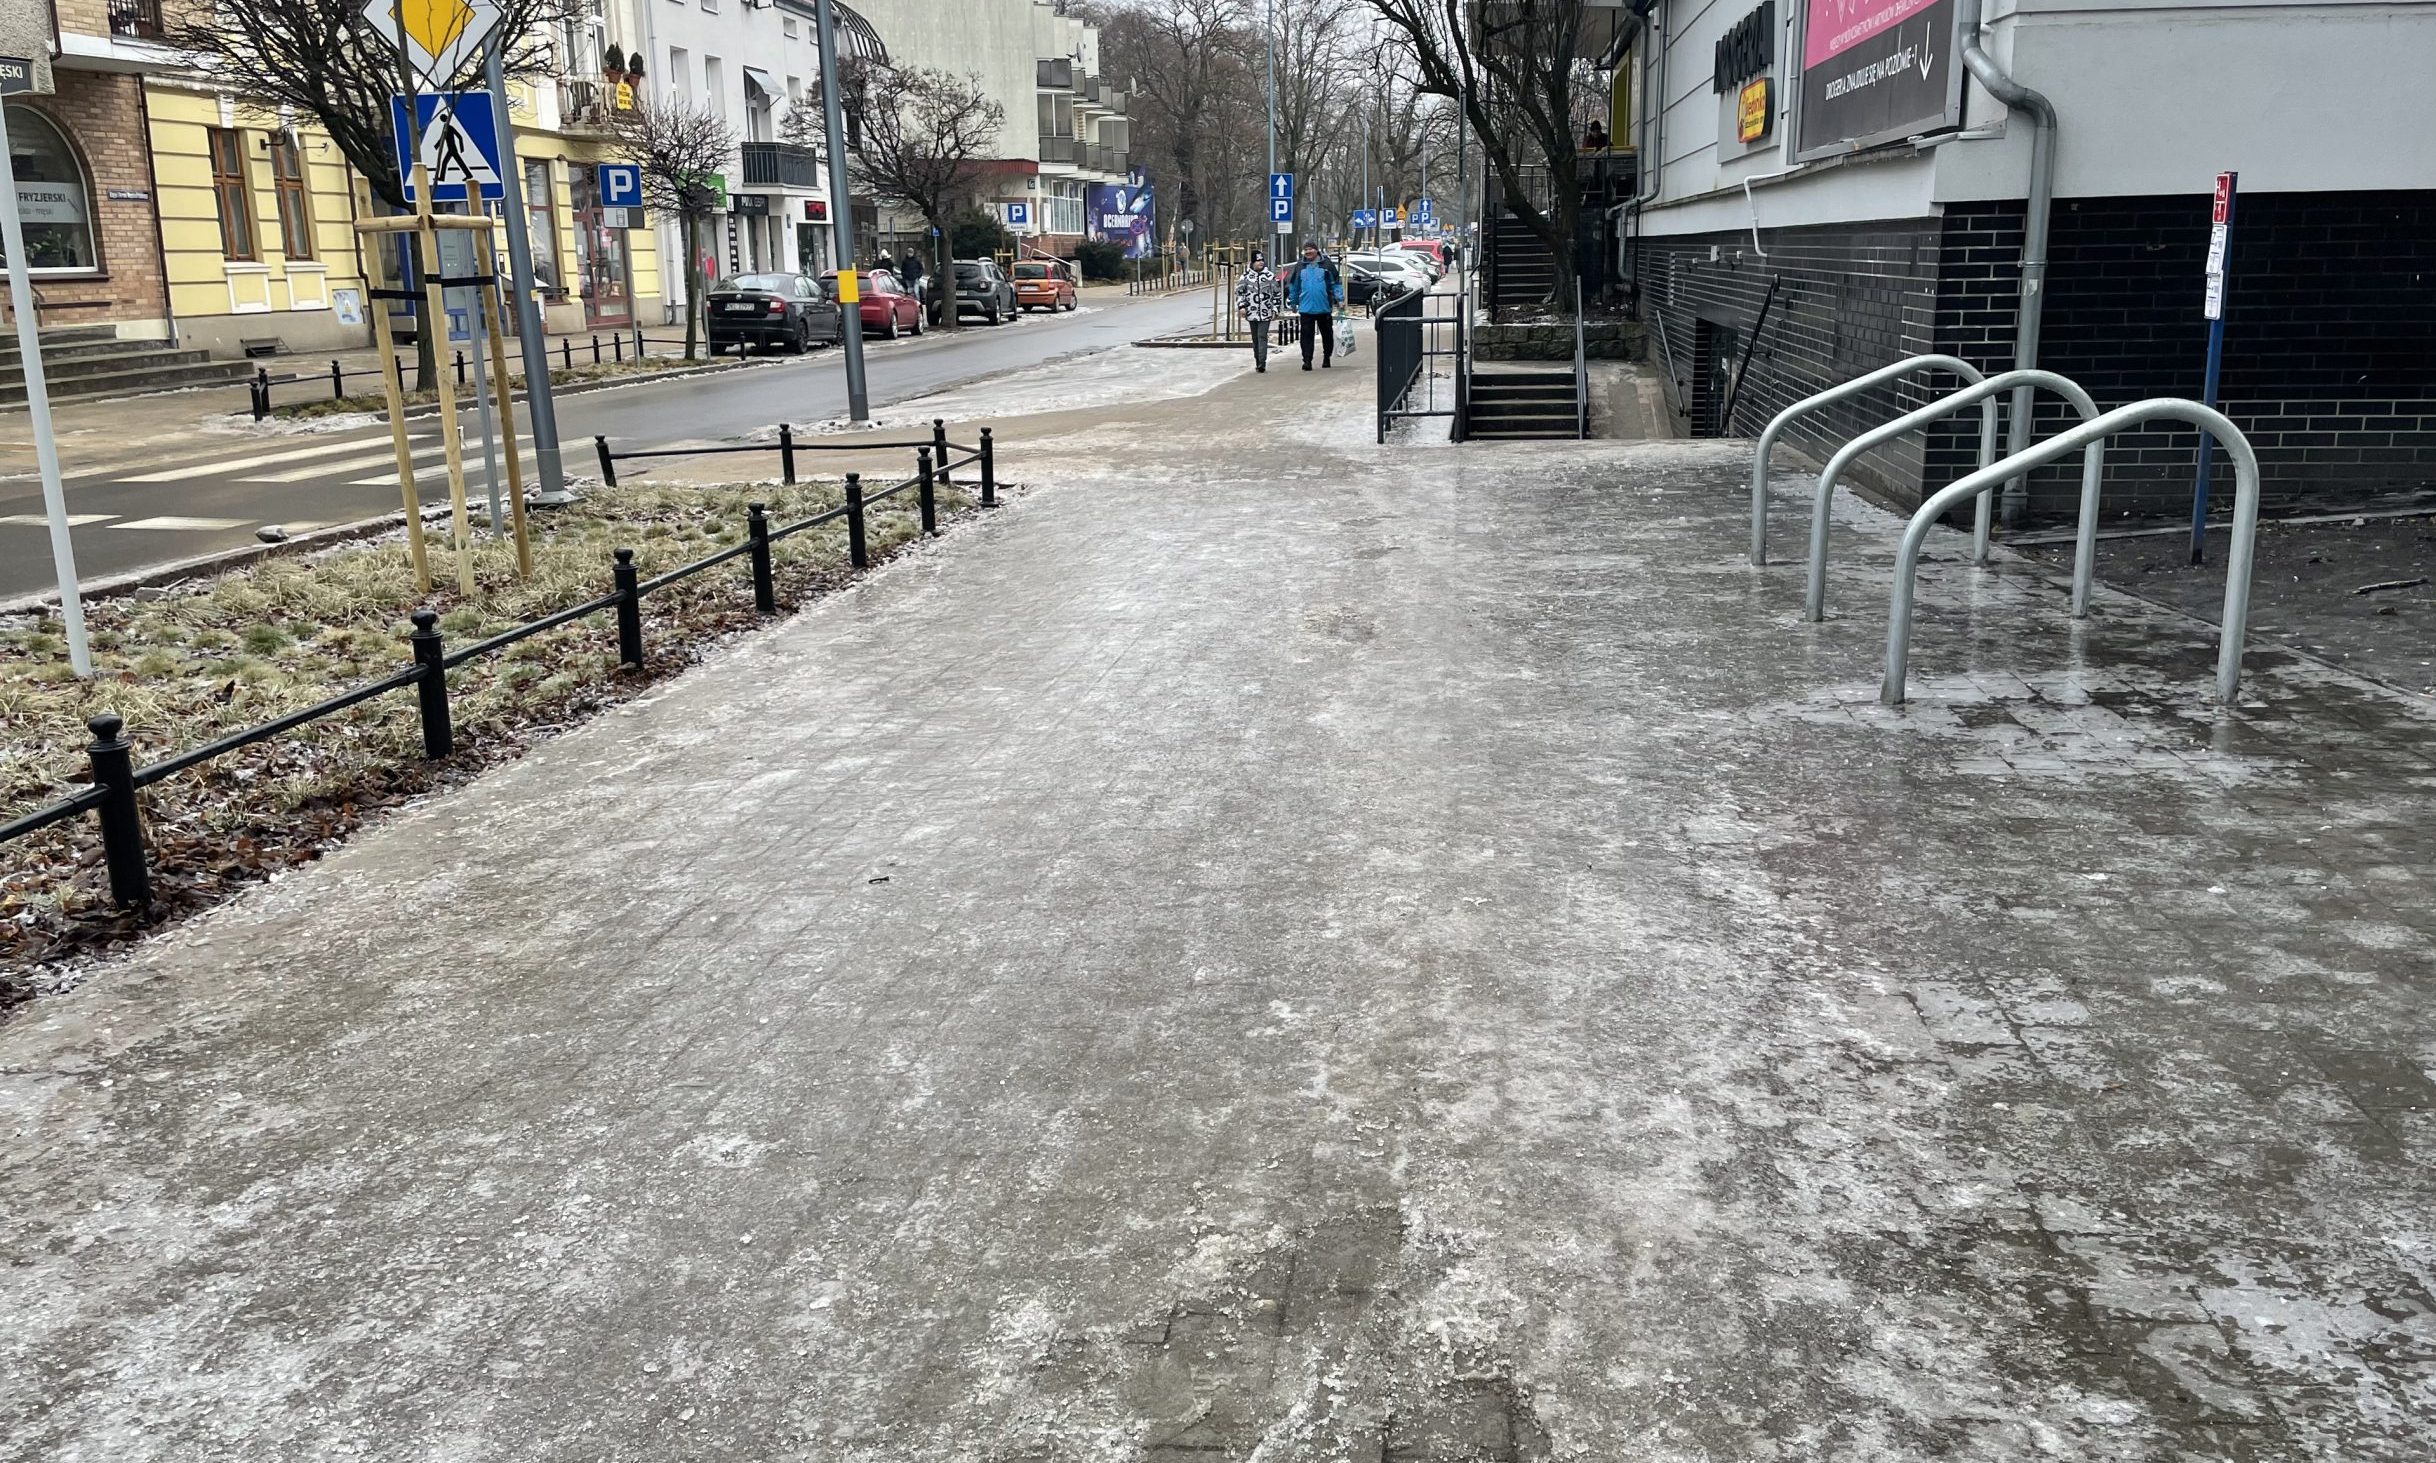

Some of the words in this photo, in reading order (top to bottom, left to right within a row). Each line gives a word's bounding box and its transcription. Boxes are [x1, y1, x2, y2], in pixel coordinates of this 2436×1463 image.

[1868, 63, 1877, 87] SIĘ
[1876, 59, 1885, 81] NA
[1885, 47, 1912, 77] POZIOMIE
[608, 169, 633, 202] P
[18, 192, 67, 203] FRYZJERSKI
[1011, 205, 1023, 222] P
[1275, 200, 1289, 219] P
[1385, 209, 1395, 222] P
[1421, 212, 1430, 223] P
